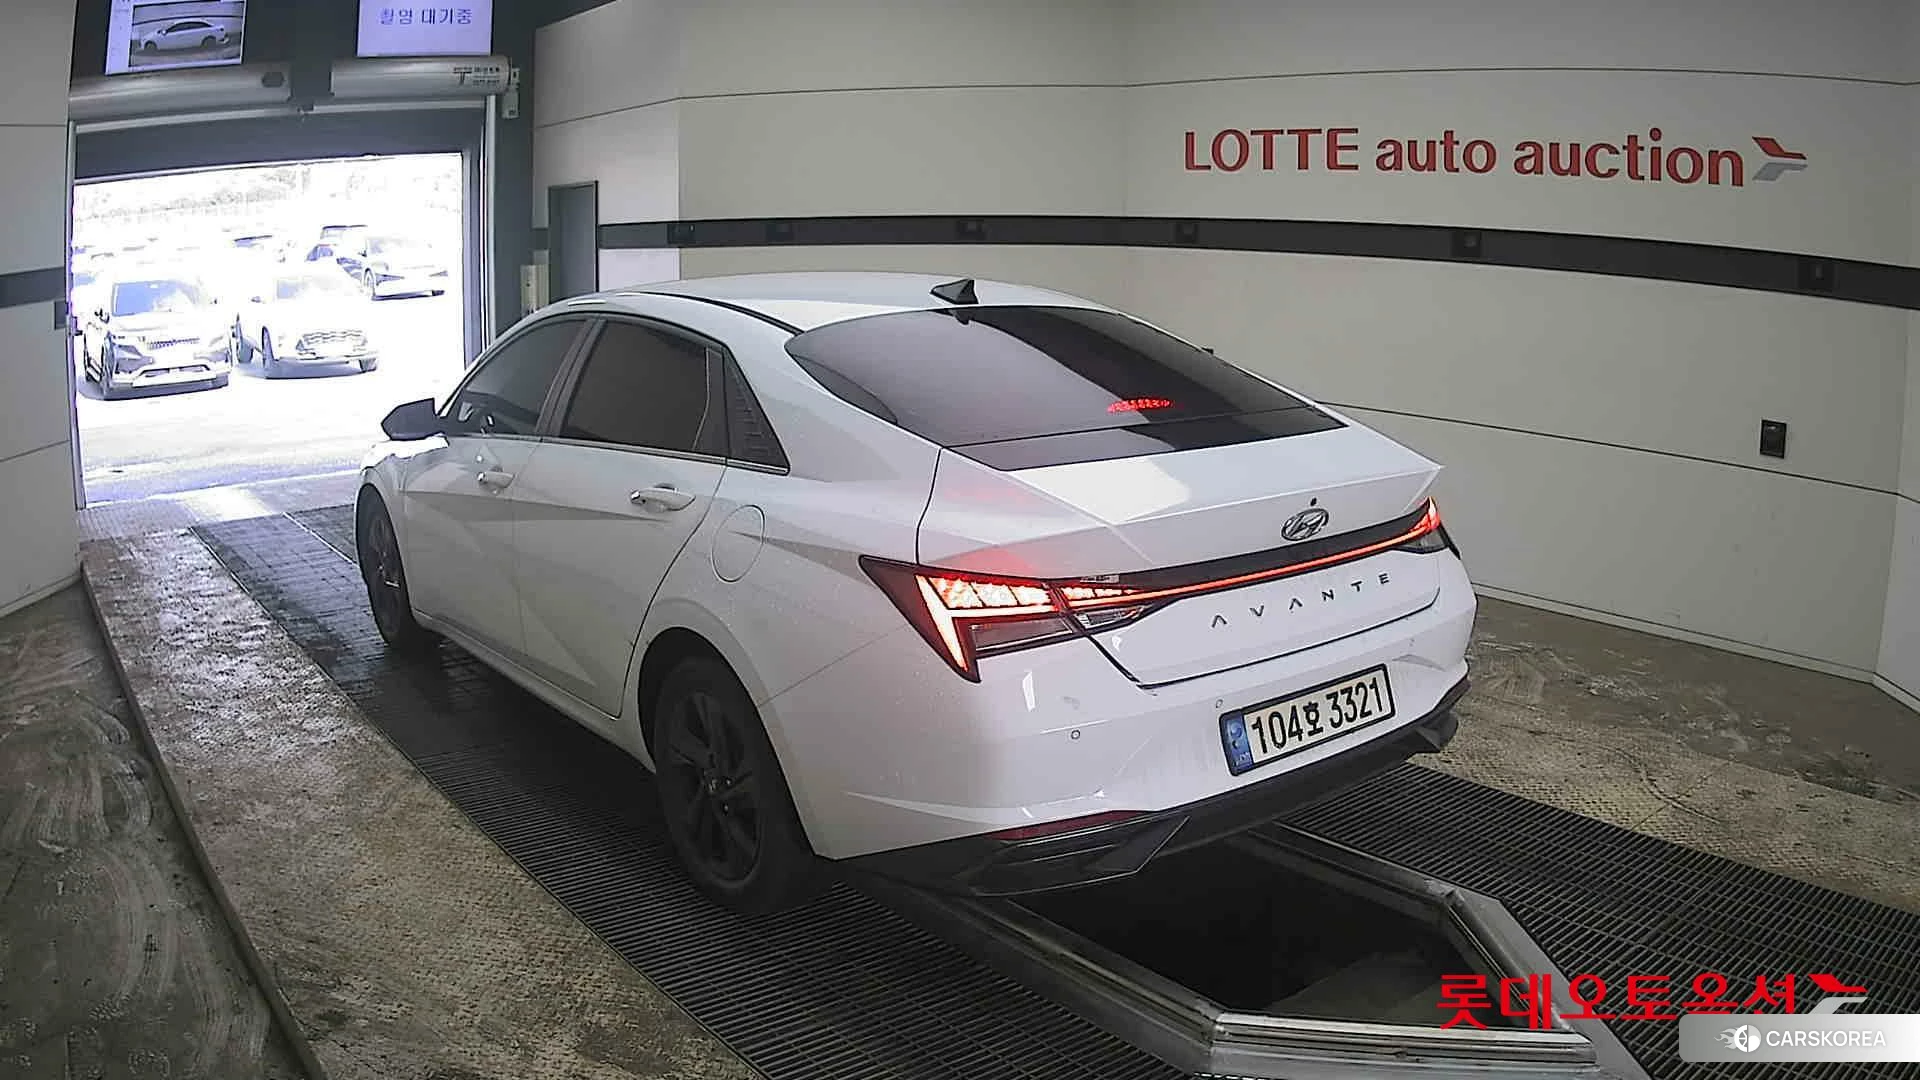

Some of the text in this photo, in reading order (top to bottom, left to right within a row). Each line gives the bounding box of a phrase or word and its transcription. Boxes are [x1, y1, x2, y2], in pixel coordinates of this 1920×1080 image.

[422, 7, 473, 25] 대기중
[1184, 127, 1744, 187] LOTTE auto auction
[1210, 572, 1391, 628] AVANTE
[1251, 676, 1383, 754] 104호 3321
